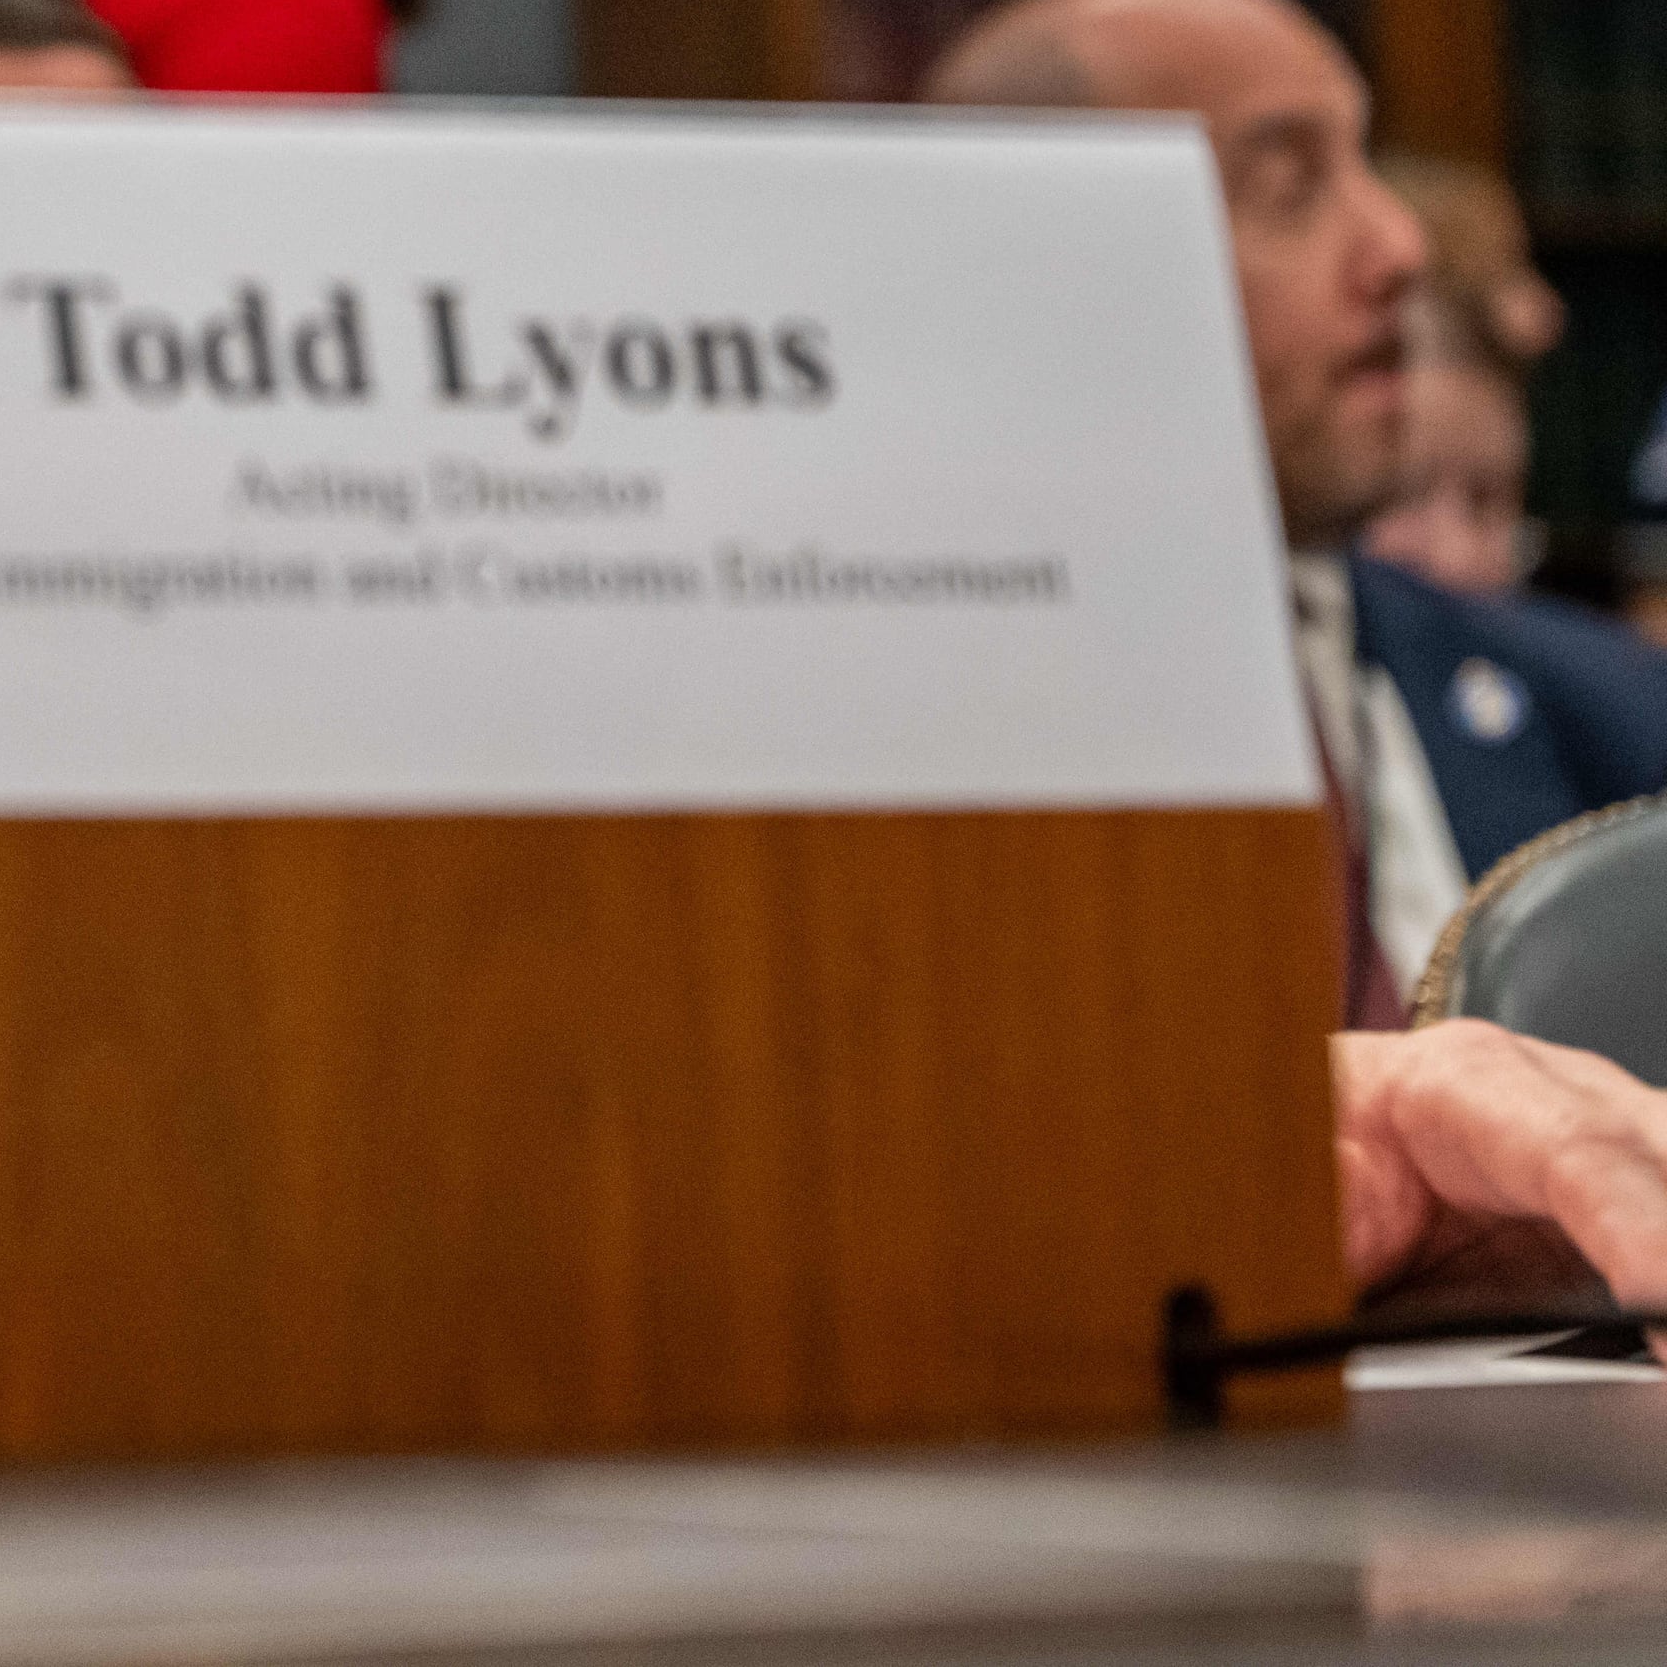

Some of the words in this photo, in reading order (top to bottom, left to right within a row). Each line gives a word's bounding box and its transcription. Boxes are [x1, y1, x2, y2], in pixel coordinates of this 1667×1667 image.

[2, 273, 373, 404] Todd
[421, 278, 839, 442] Lyons
[230, 456, 417, 525] Acting
[428, 456, 663, 518] Director
[346, 542, 439, 608] and
[449, 541, 703, 607] Customs
[713, 539, 1071, 608] Enforcement
